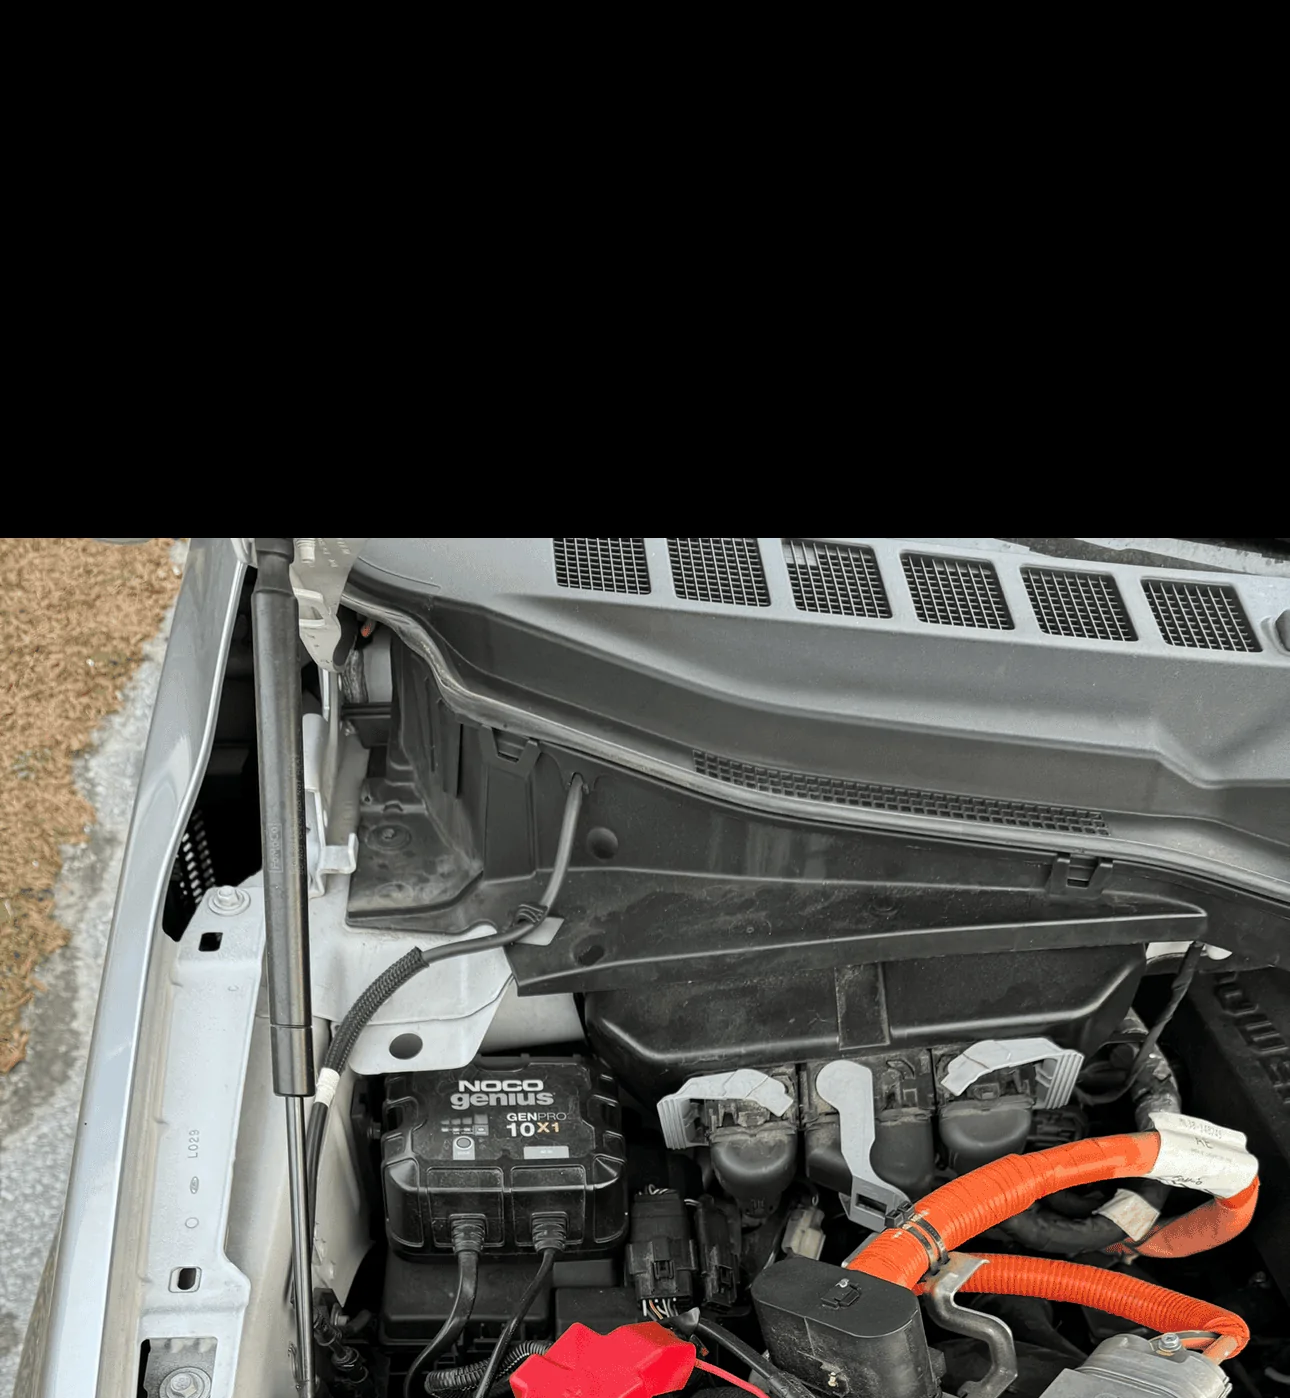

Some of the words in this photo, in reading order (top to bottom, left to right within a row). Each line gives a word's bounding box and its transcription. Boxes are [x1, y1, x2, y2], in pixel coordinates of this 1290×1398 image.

[268, 825, 281, 872] FoMoCo
[458, 1080, 544, 1092] NOCO
[450, 1092, 554, 1110] genius
[506, 1112, 566, 1121] GENPRO
[186, 1128, 200, 1159] L029
